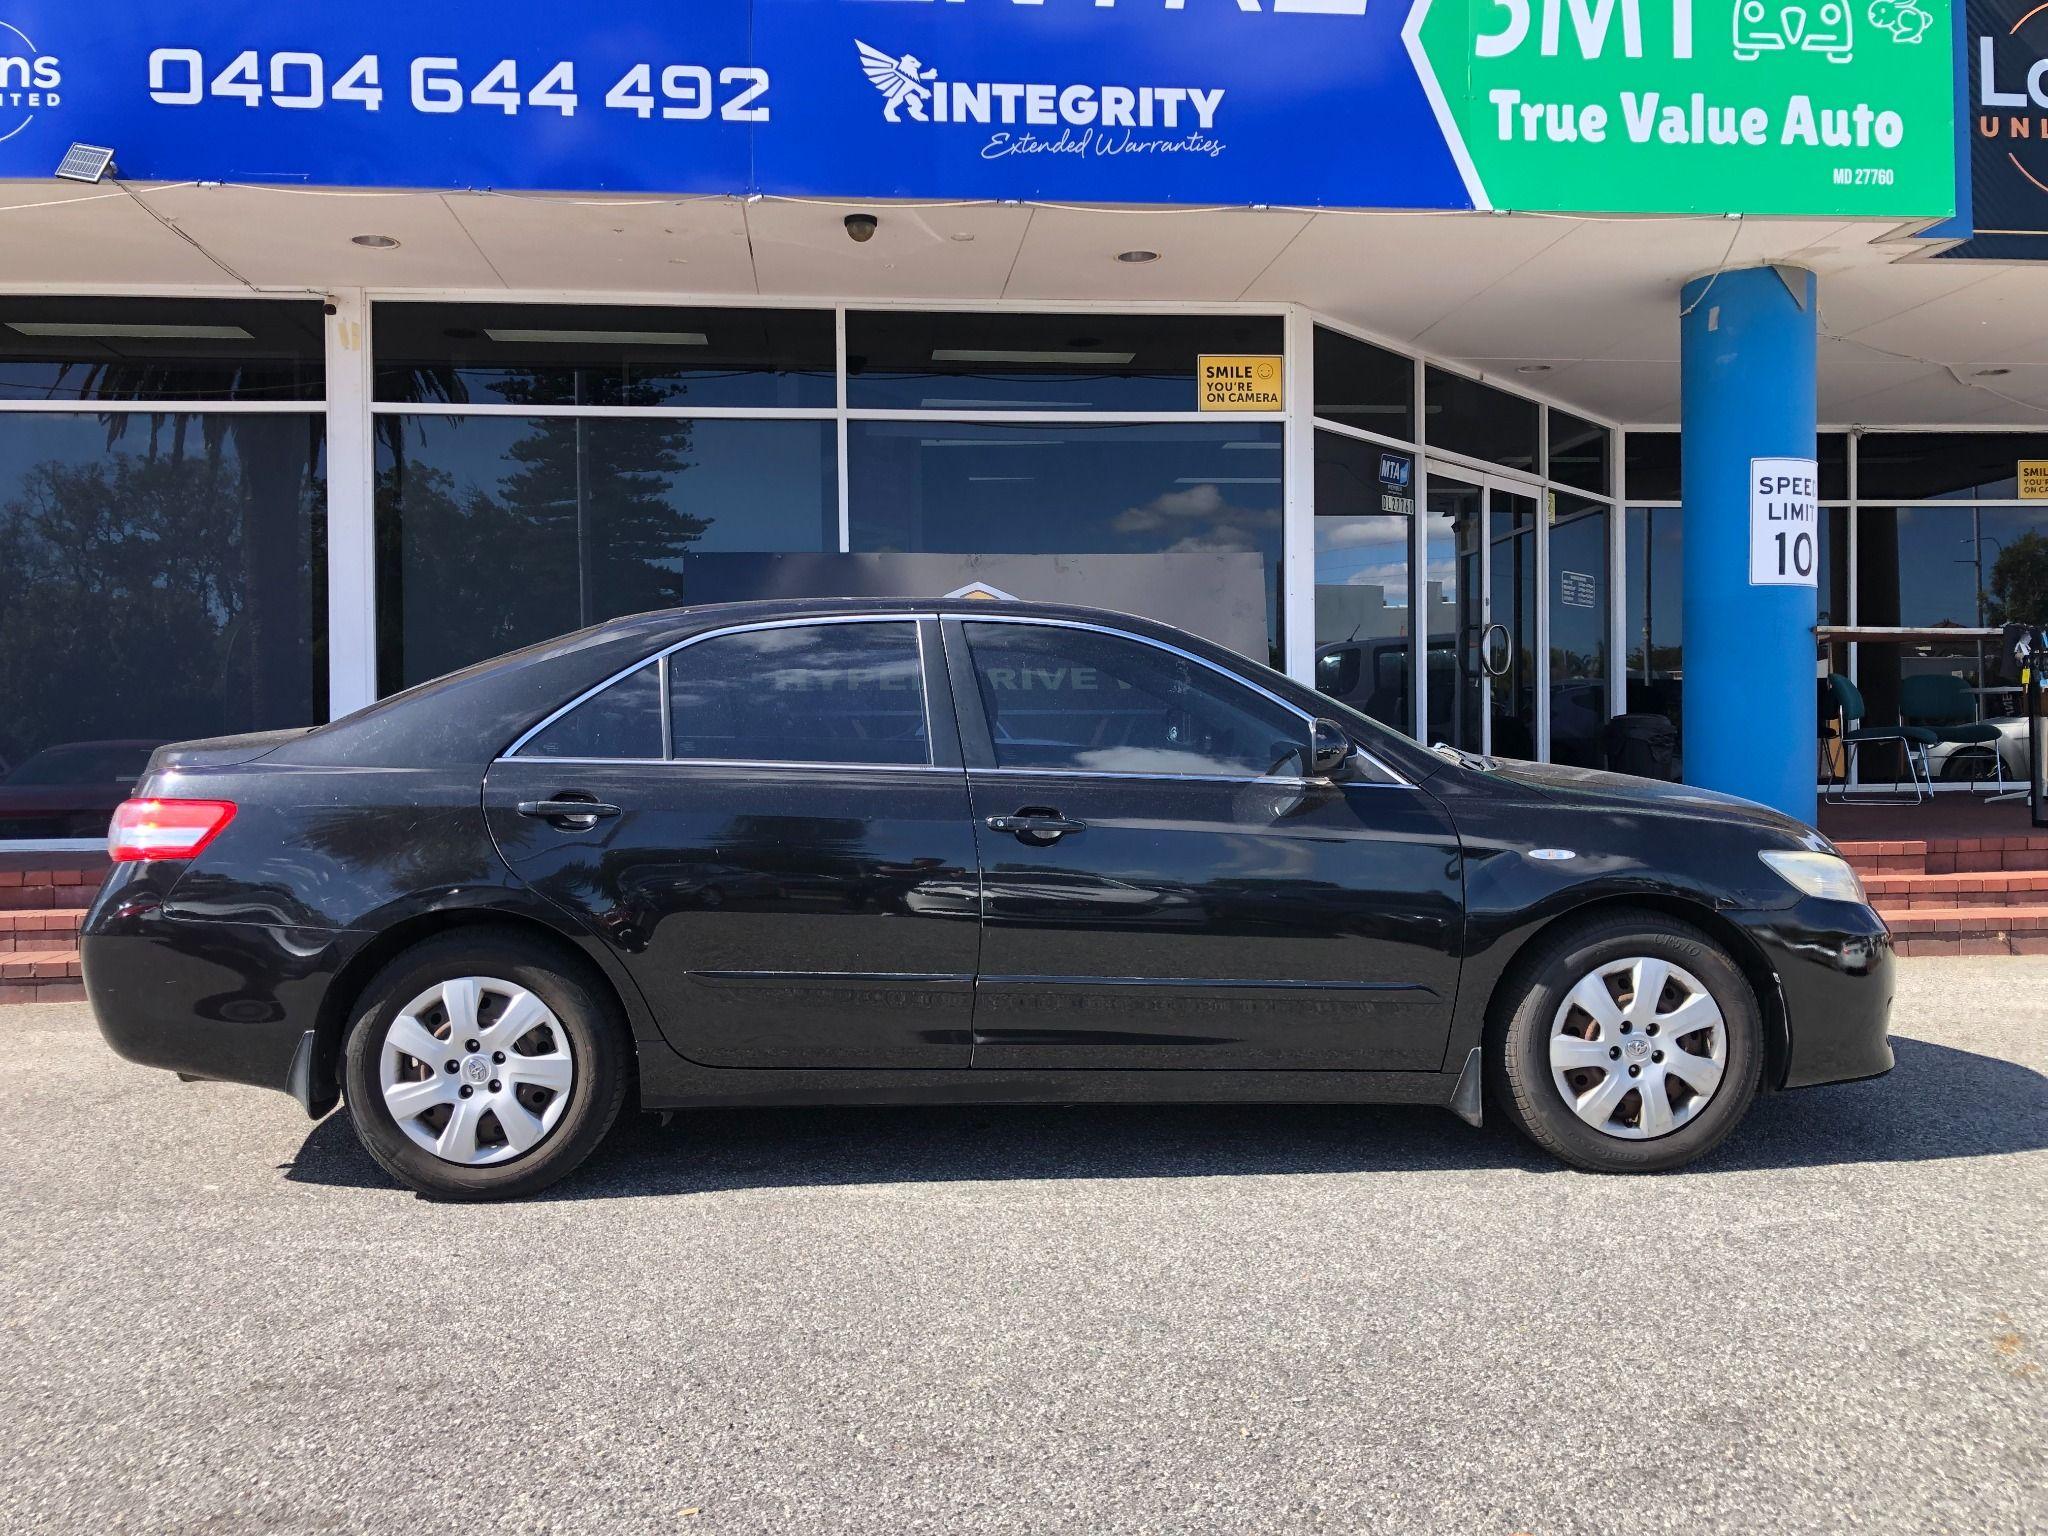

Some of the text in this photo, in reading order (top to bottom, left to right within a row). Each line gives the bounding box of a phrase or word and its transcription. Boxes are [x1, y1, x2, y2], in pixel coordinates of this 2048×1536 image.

[149, 48, 770, 122] 0404 644 492
[933, 81, 1226, 128] INTEGRITY
[1489, 89, 1903, 148] True Value Auto
[981, 128, 1226, 159] Extended Warranties
[1833, 168, 1894, 185] MD 27760
[1206, 366, 1253, 379] SMILE
[1206, 382, 1253, 392] YOU'RE
[1207, 393, 1278, 403] ON CAMERA
[1381, 460, 1400, 480] MTA
[1775, 532, 1813, 577] 10
